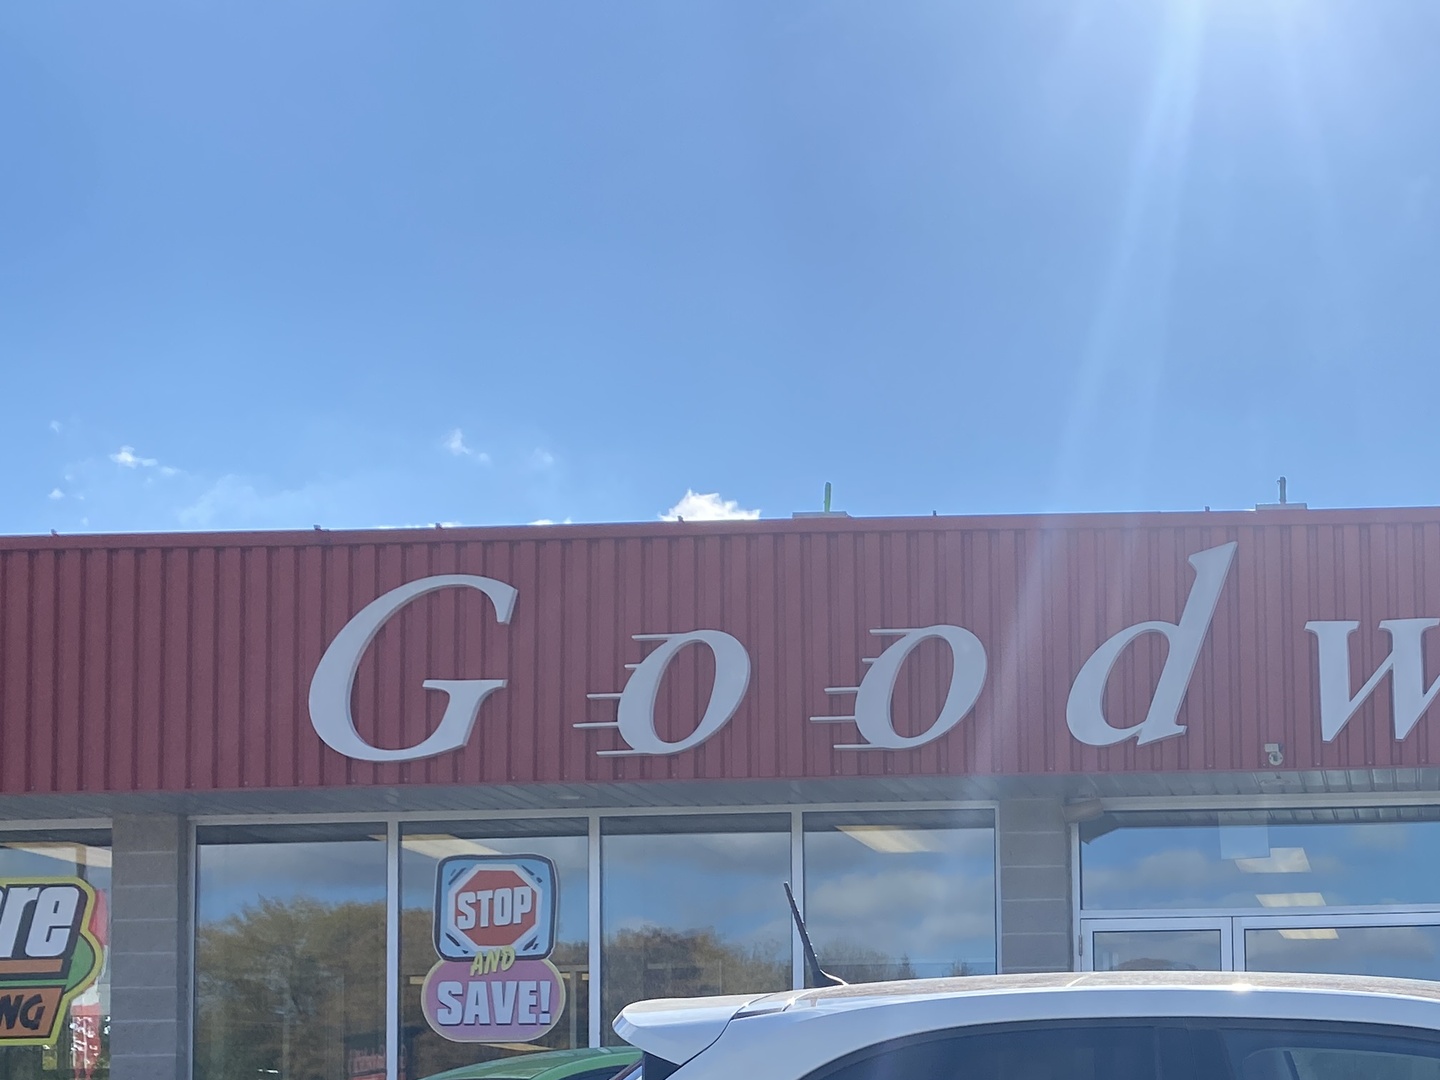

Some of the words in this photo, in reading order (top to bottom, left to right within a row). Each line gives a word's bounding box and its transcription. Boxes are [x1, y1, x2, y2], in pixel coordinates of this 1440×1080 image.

[0, 885, 80, 958] re
[456, 885, 533, 931] STOP
[469, 945, 517, 978] AND
[436, 980, 552, 1027] SAVE!
